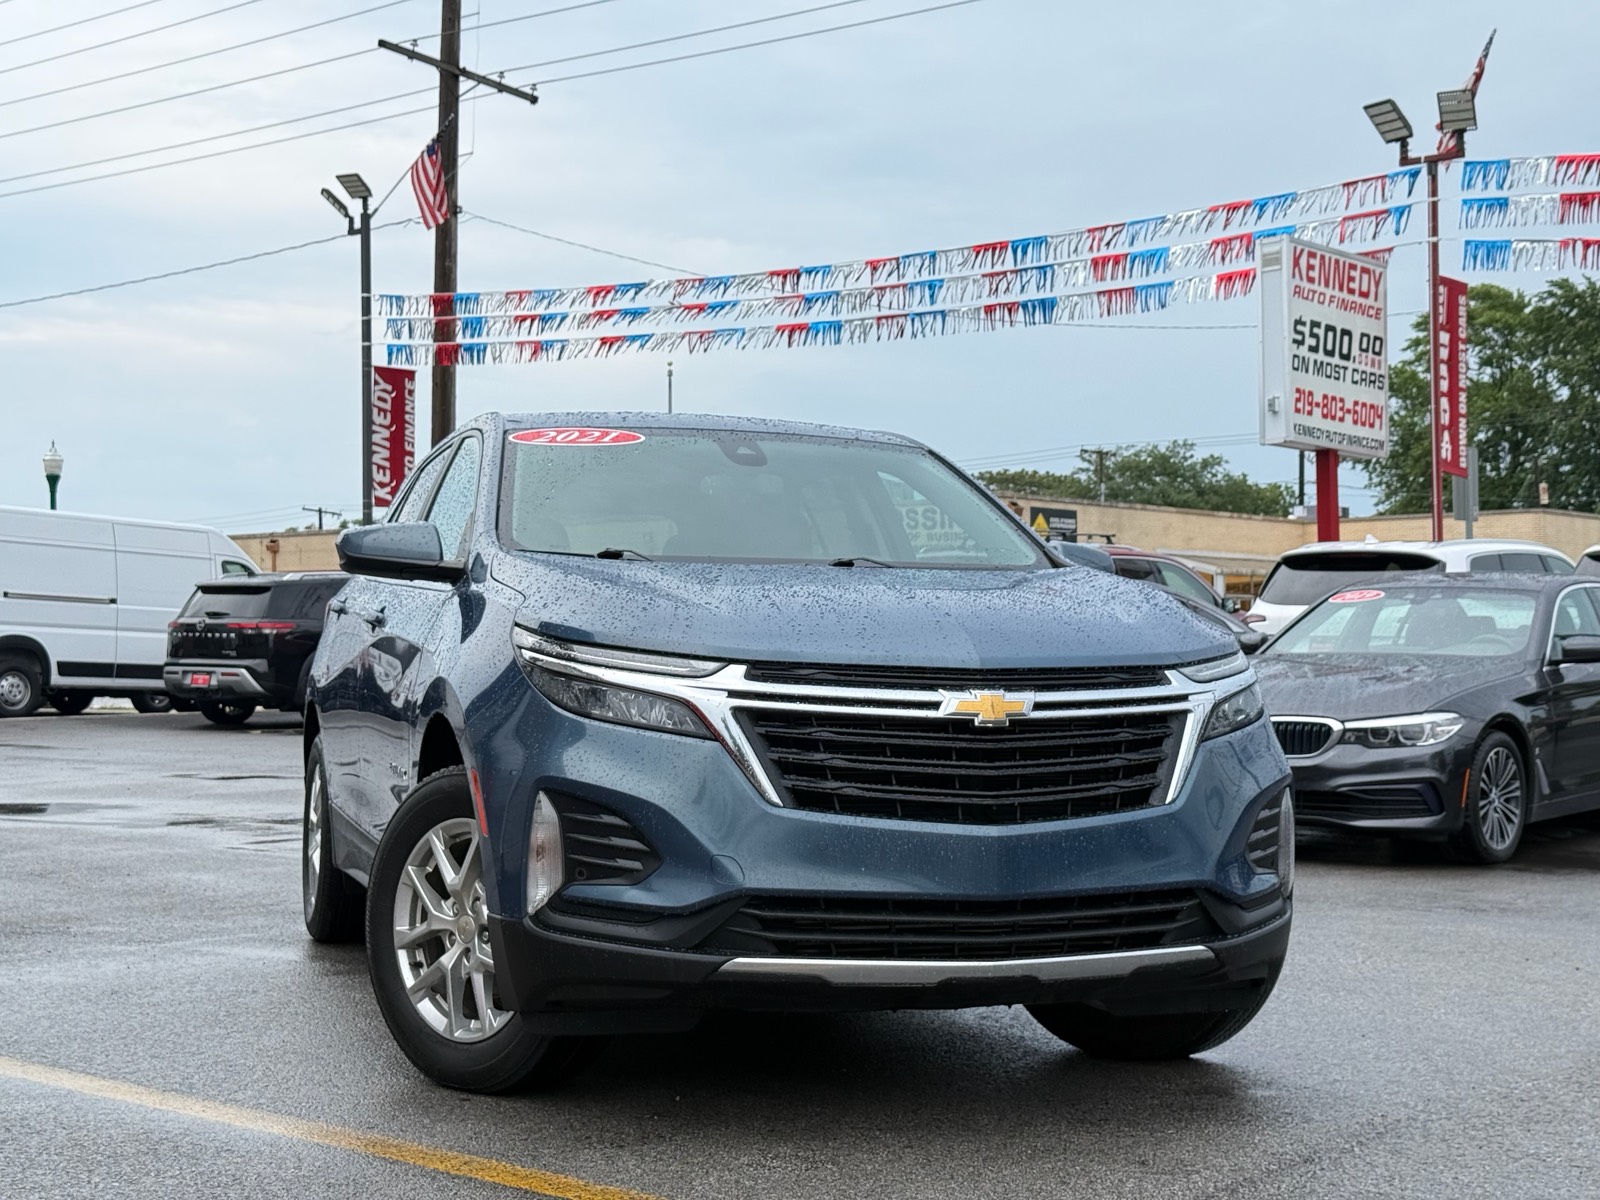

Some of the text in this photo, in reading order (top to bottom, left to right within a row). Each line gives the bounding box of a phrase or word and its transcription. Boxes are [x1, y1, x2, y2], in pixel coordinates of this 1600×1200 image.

[1292, 246, 1383, 302] KENNEDY
[1293, 285, 1383, 321] AUTO FINANCE
[1292, 354, 1385, 391] ON MOST CARS
[1458, 295, 1467, 468] DOWN ON MOST CARS
[404, 378, 416, 452] FINANCE
[1294, 387, 1384, 431] 219-803-6004
[372, 372, 396, 502] KENNEDY
[531, 431, 620, 442] 2021
